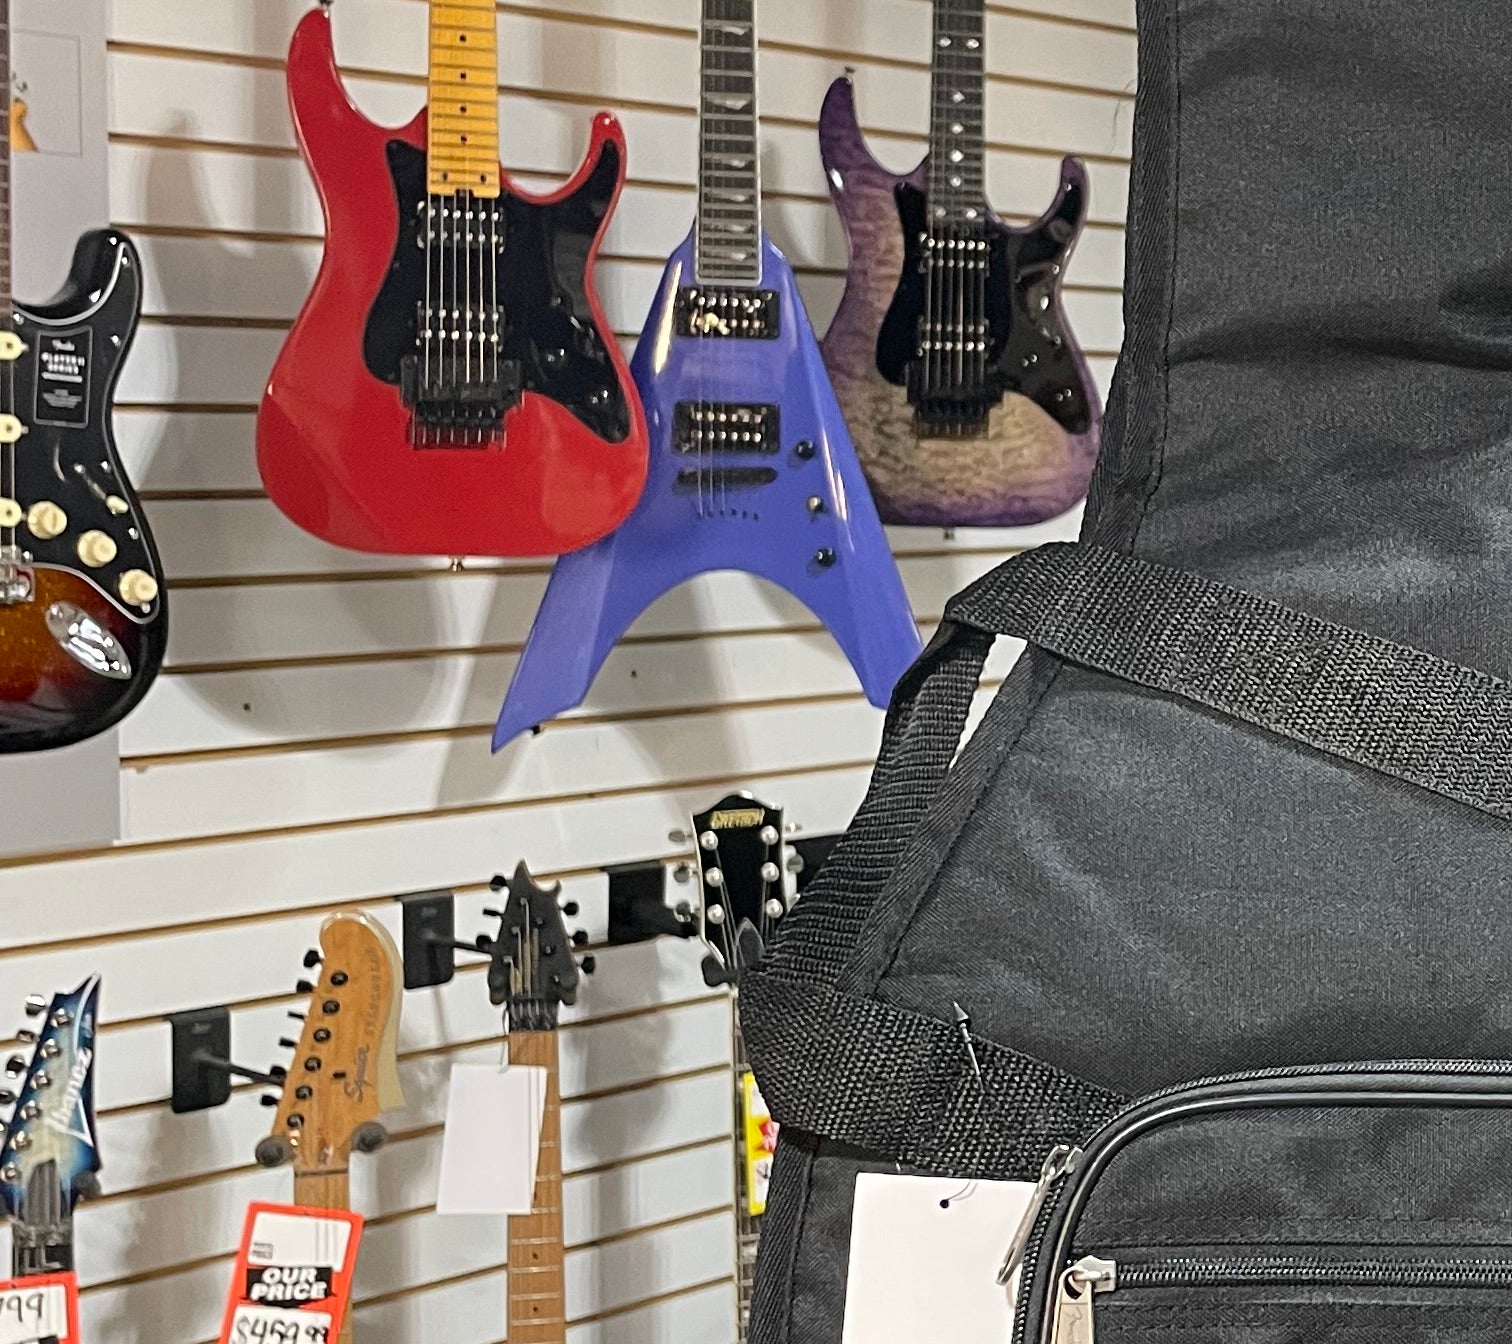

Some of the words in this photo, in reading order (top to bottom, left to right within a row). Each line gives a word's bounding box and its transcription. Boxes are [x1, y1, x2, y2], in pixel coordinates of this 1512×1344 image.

[261, 1267, 319, 1284] OUR
[250, 1281, 328, 1301] PRICE
[0, 1292, 44, 1323] 99
